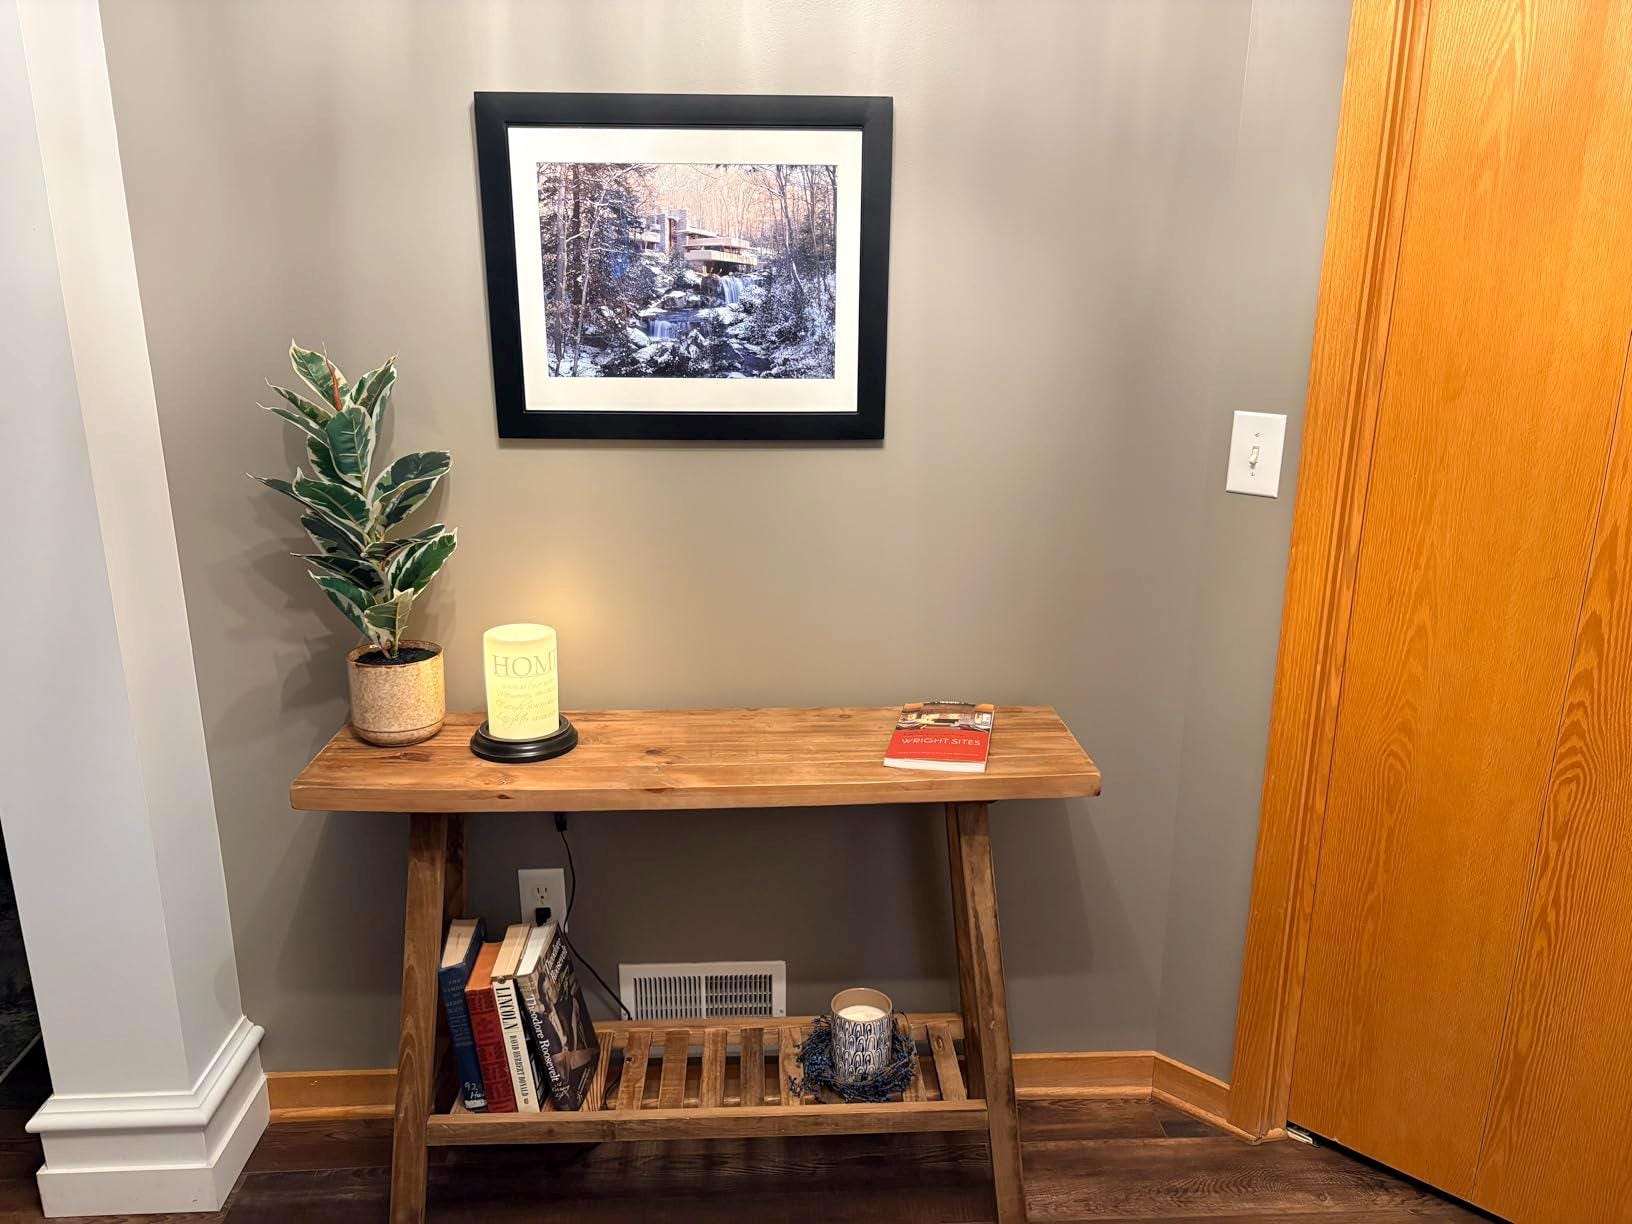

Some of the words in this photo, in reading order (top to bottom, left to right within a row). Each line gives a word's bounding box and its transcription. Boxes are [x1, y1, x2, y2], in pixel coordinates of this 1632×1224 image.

[951, 738, 981, 746] SITES
[495, 986, 518, 1030] LINCOLN
[526, 994, 545, 1039] Theodore
[538, 1039, 559, 1083] Roosevelt
[464, 1081, 478, 1091] 92
